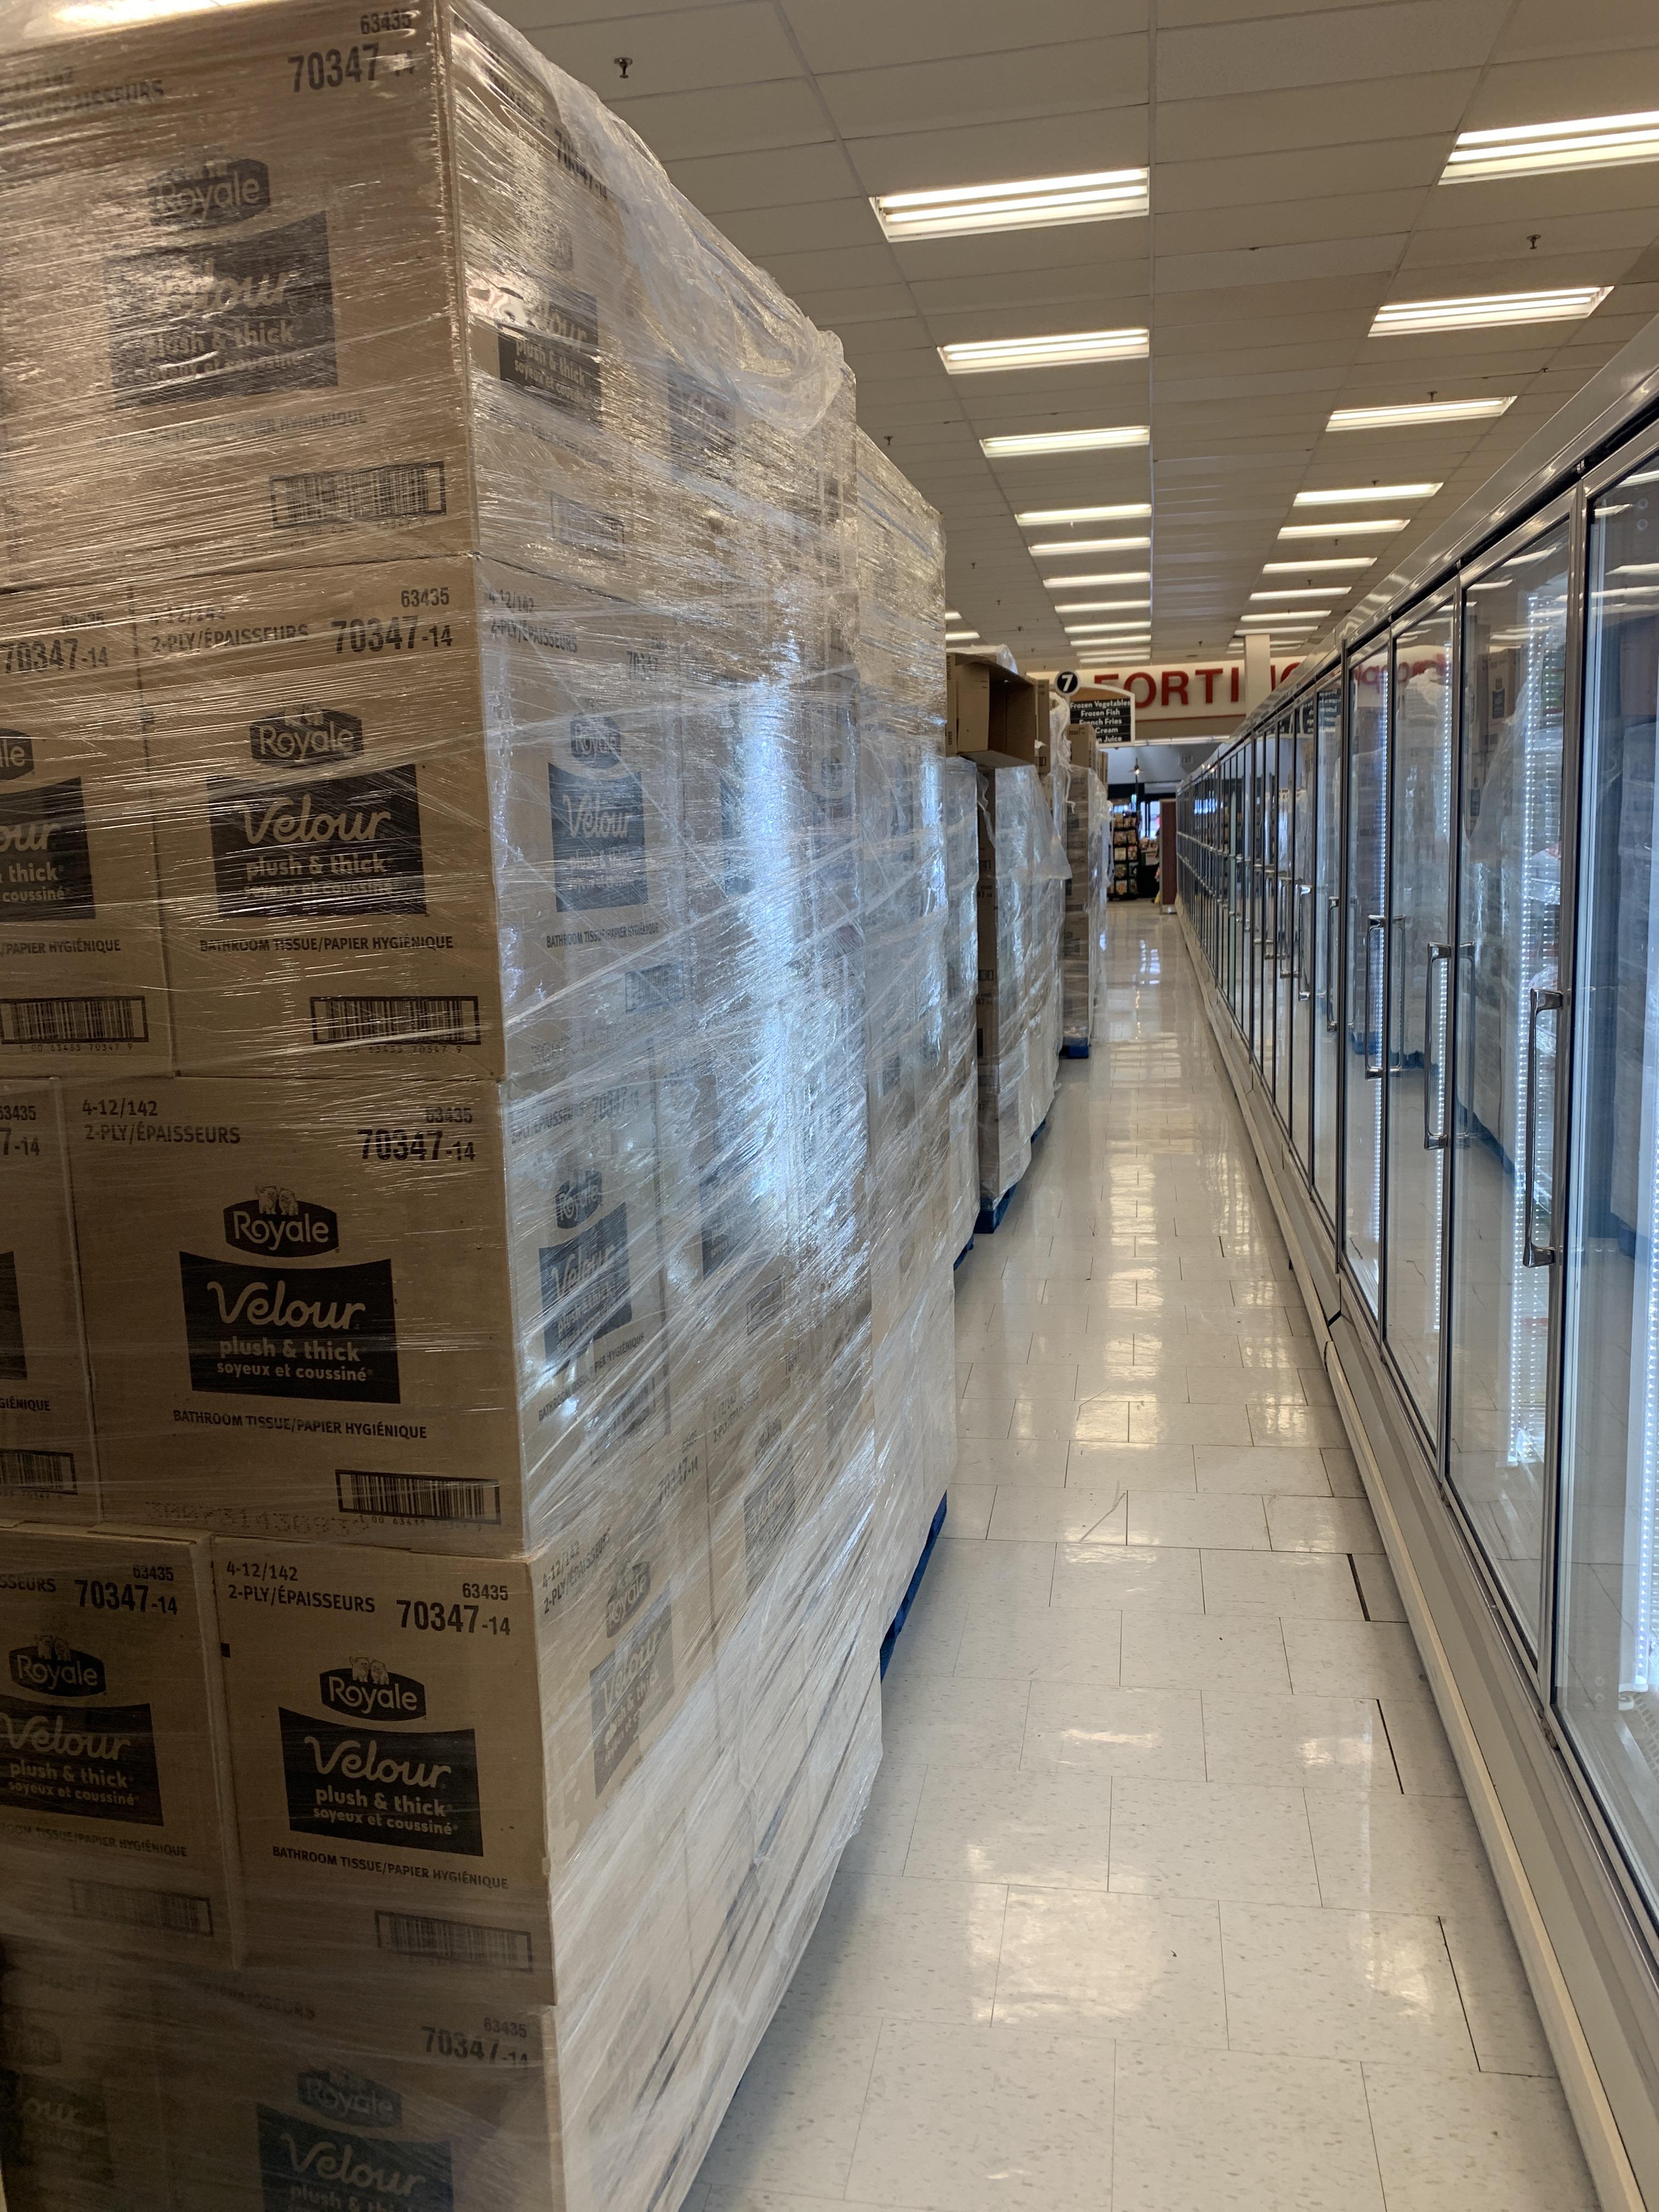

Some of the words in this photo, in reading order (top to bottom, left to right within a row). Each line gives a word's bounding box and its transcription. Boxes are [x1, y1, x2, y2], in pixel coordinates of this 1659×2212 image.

[360, 8, 412, 35] 63435
[158, 171, 260, 220] Royale
[400, 587, 450, 607] 63435
[489, 589, 534, 613] 412/142
[331, 615, 453, 654] 70347-14
[1, 638, 109, 674] 70347-14
[1062, 674, 1074, 692] 7
[1094, 699, 1131, 709] Vegetables
[259, 721, 354, 760] Royale
[234, 793, 391, 844] Velour
[9, 861, 59, 883] thick
[246, 852, 302, 881] plush
[329, 852, 385, 876] thick
[2, 885, 65, 902] coussiné
[49, 939, 121, 954] HYGIÉNIQUE
[200, 939, 270, 952] BATHROOM
[274, 936, 369, 952] TISSUE/PAPIER
[373, 934, 454, 951] HYGIÉNIQUE
[82, 1098, 159, 1119] 4-12/142
[426, 1107, 472, 1124] 63435
[84, 1120, 241, 1145] 2-PLY/ÉPAISSEURS
[358, 1129, 476, 1161] 70347-14
[233, 1211, 329, 1251] Royale
[207, 1280, 366, 1330] Velour
[220, 1336, 275, 1359] plush
[282, 1339, 297, 1358] &
[304, 1341, 360, 1362] thick
[217, 1363, 270, 1378] soyeux
[275, 1362, 291, 1378] et
[295, 1368, 366, 1381] coussiné
[173, 1409, 242, 1426] BATHROOM
[246, 1415, 342, 1435] TISSUE/PAPIER
[346, 1422, 427, 1440] HYGIÉNIQUE
[132, 1566, 174, 1581] 63435
[227, 1561, 298, 1581] 4-12/142
[74, 1579, 178, 1615] 70347-14
[228, 1584, 376, 1613] 2-PLY/ÉPAISSEURS
[462, 1582, 509, 1601] 63435
[396, 1599, 511, 1635] 70347-14
[17, 1654, 98, 1690] Royale
[329, 1677, 417, 1714] Royale
[0, 1712, 131, 1760] Velour
[10, 1758, 57, 1779] plush
[63, 1765, 76, 1782] &
[81, 1767, 128, 1788] thick
[304, 1735, 452, 1788] Velour
[58, 1786, 71, 1799] et
[75, 1790, 135, 1807] coussiné
[315, 1785, 368, 1808] plush
[374, 1792, 388, 1810] &
[394, 1795, 447, 1818] thick
[313, 1808, 363, 1824] soyeux
[367, 1812, 383, 1827] et
[386, 1817, 453, 1836] coussiné
[119, 1838, 189, 1858] HYGIÉNIQUE
[273, 1846, 338, 1866] BATHROOM
[340, 1856, 430, 1880] TISSUE/PAPIER
[433, 1867, 509, 1890] HYGIÉNIQUE
[483, 2017, 527, 2039] 63435
[306, 2076, 393, 2120] Royale
[280, 2132, 426, 2197] Velour
